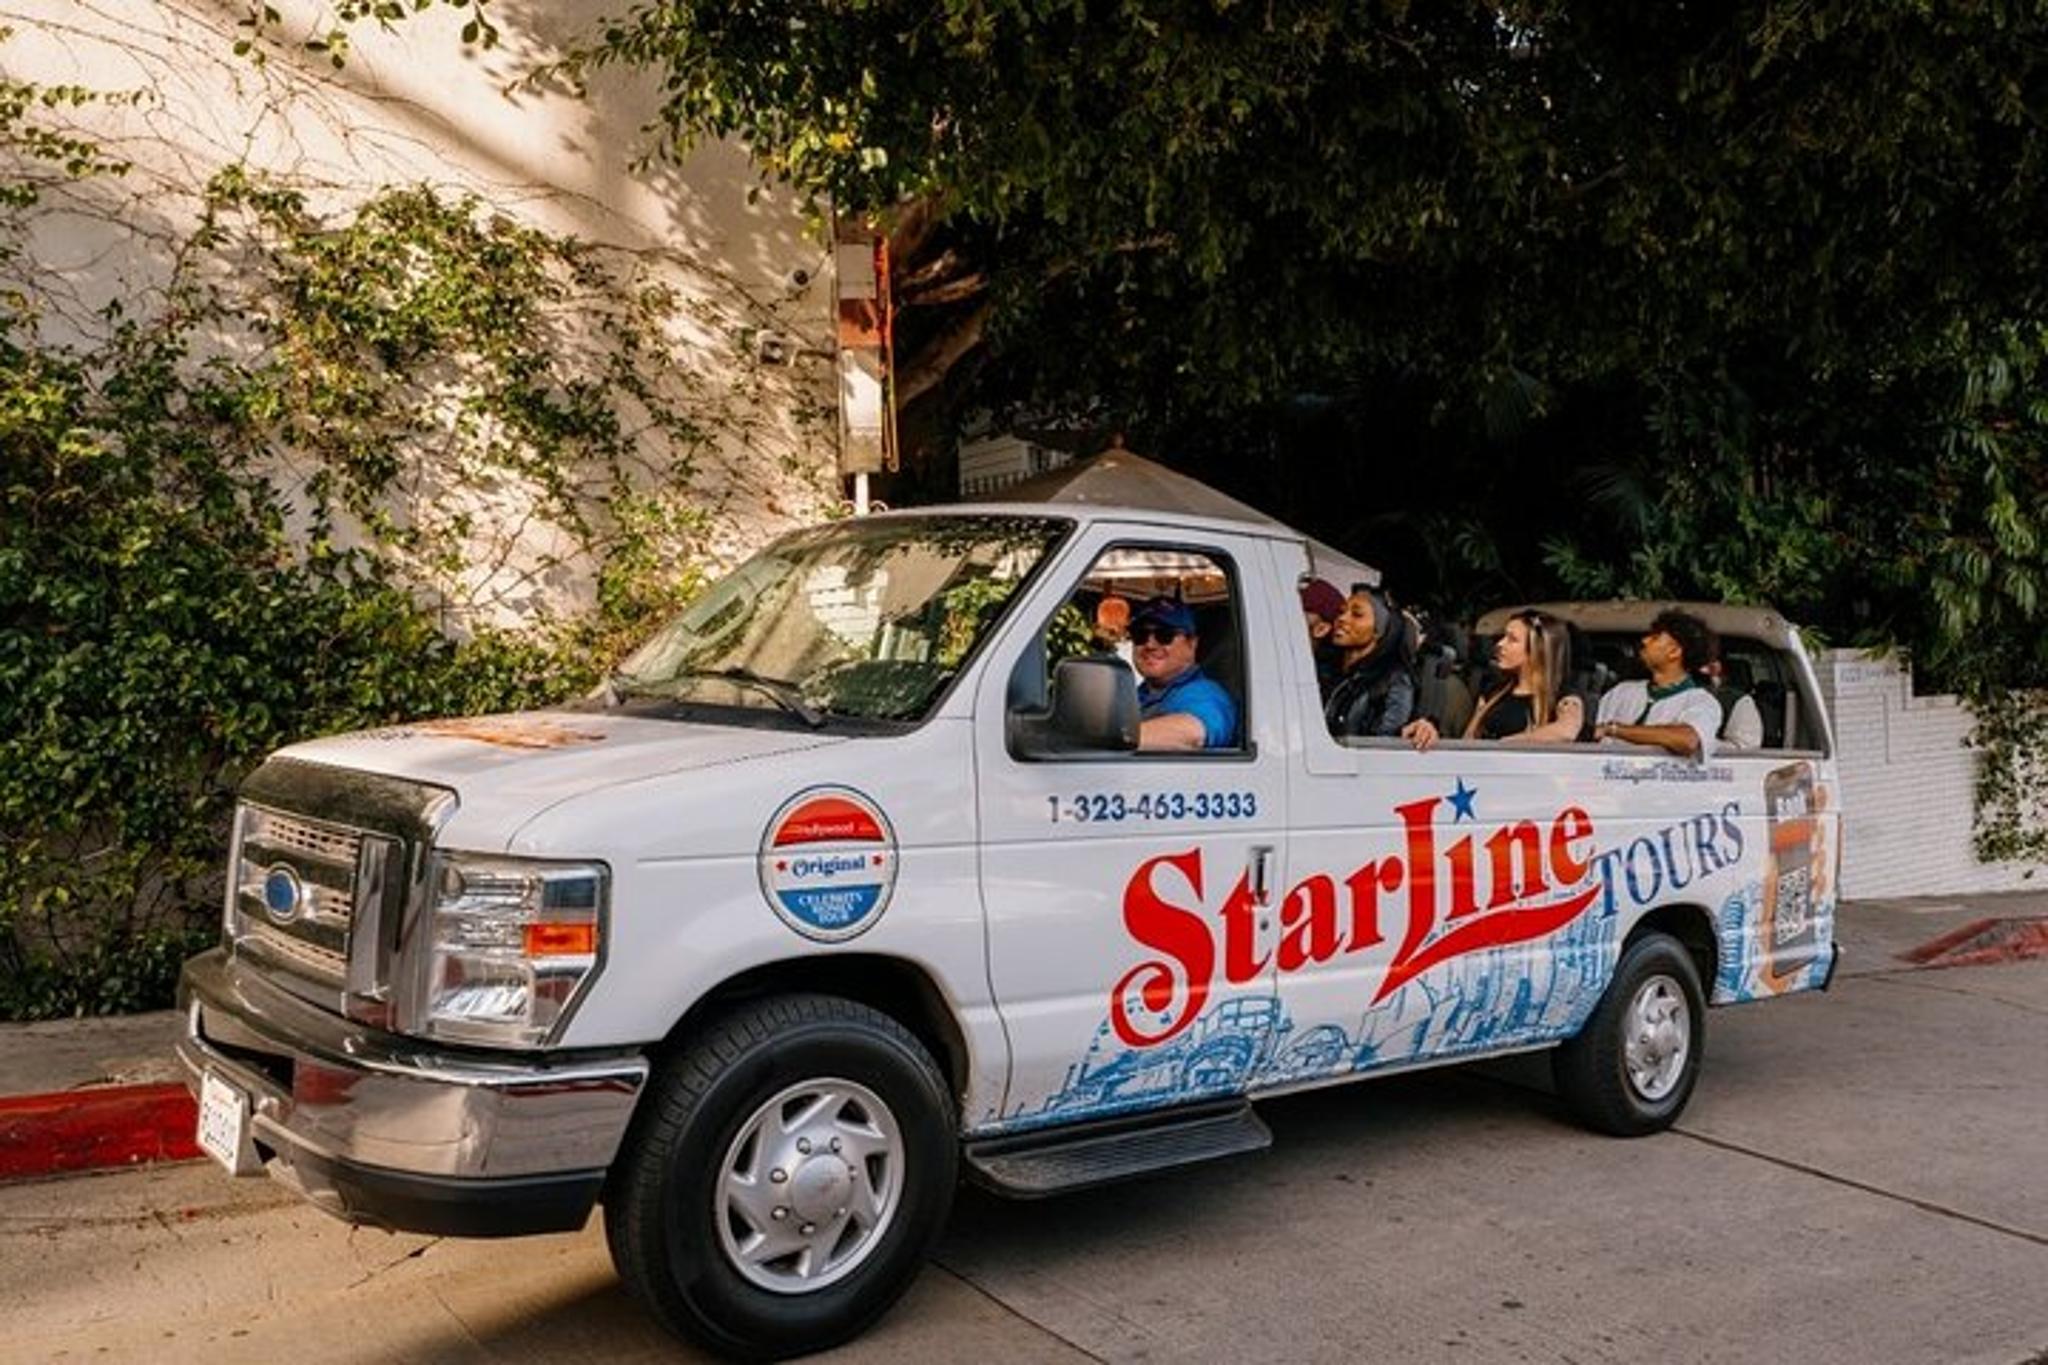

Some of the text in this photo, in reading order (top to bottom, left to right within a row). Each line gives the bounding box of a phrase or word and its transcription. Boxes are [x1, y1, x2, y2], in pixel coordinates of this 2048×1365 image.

[1048, 792, 1257, 823] 1-323-463-3333
[792, 855, 866, 877] Original
[1592, 802, 1744, 919] TOURS
